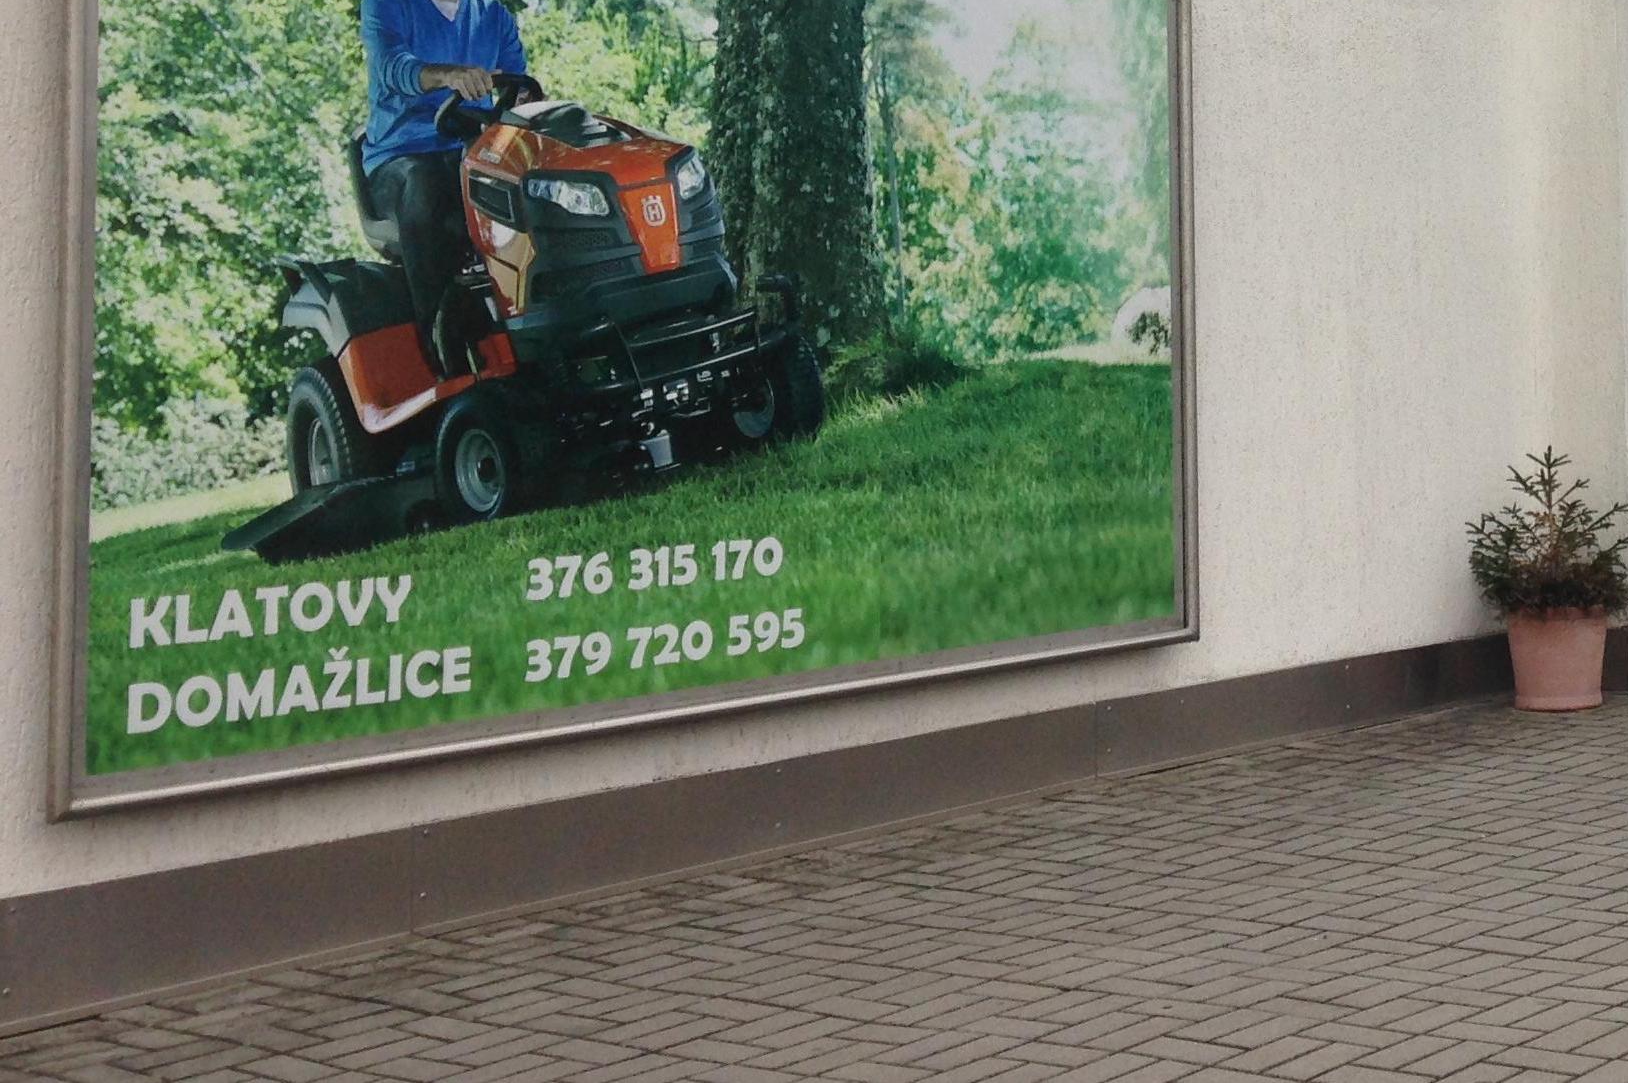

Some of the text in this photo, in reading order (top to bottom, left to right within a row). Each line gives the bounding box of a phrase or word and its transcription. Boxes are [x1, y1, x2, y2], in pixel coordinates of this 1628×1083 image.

[128, 536, 784, 649] KLATOVY 376 315 170
[126, 608, 805, 736] DOMAŽLICE 379 720 595
